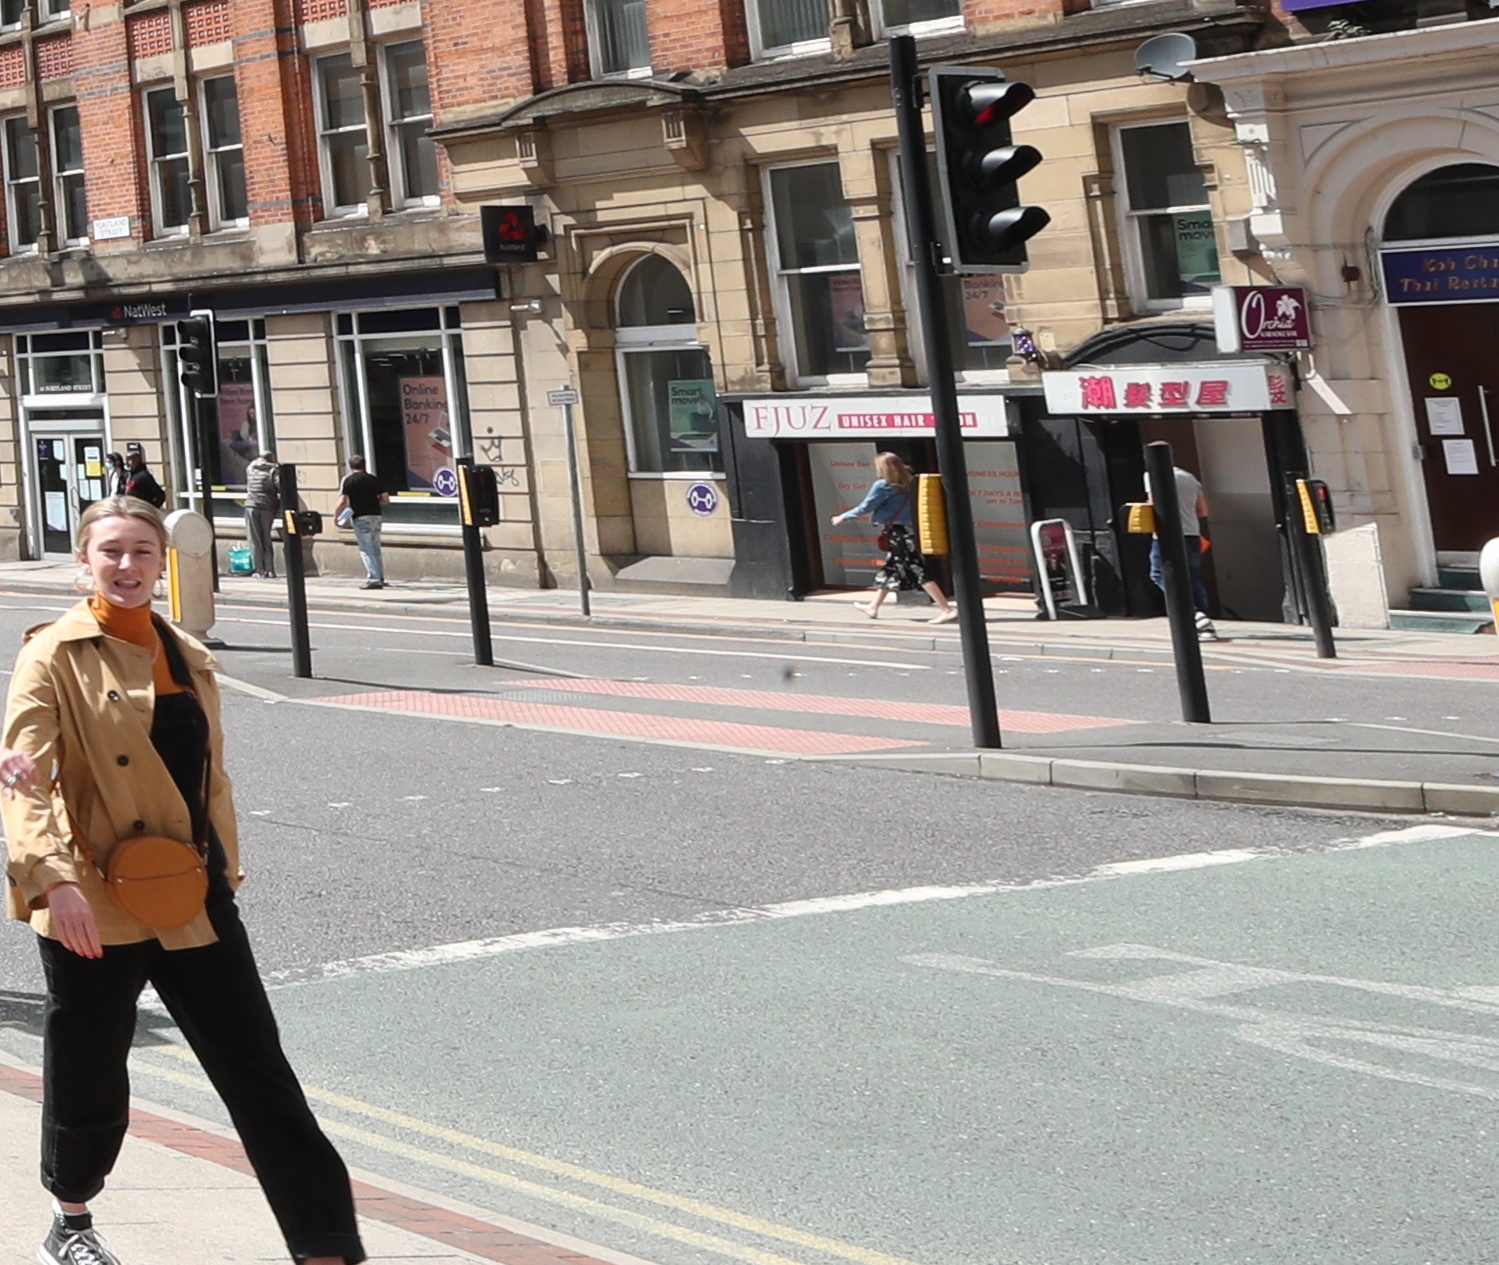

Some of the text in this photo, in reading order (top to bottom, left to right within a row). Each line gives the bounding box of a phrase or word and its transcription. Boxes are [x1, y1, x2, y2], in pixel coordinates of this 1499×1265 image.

[1178, 219, 1212, 230] Sma
[124, 303, 167, 318] NatWest
[403, 384, 439, 395] Online
[671, 387, 702, 397] Smart
[404, 399, 447, 411] Banking
[405, 413, 429, 425] 24/7
[752, 405, 831, 436] FJUZ
[842, 414, 888, 427] UNISEX
[893, 413, 925, 426] HAIR
